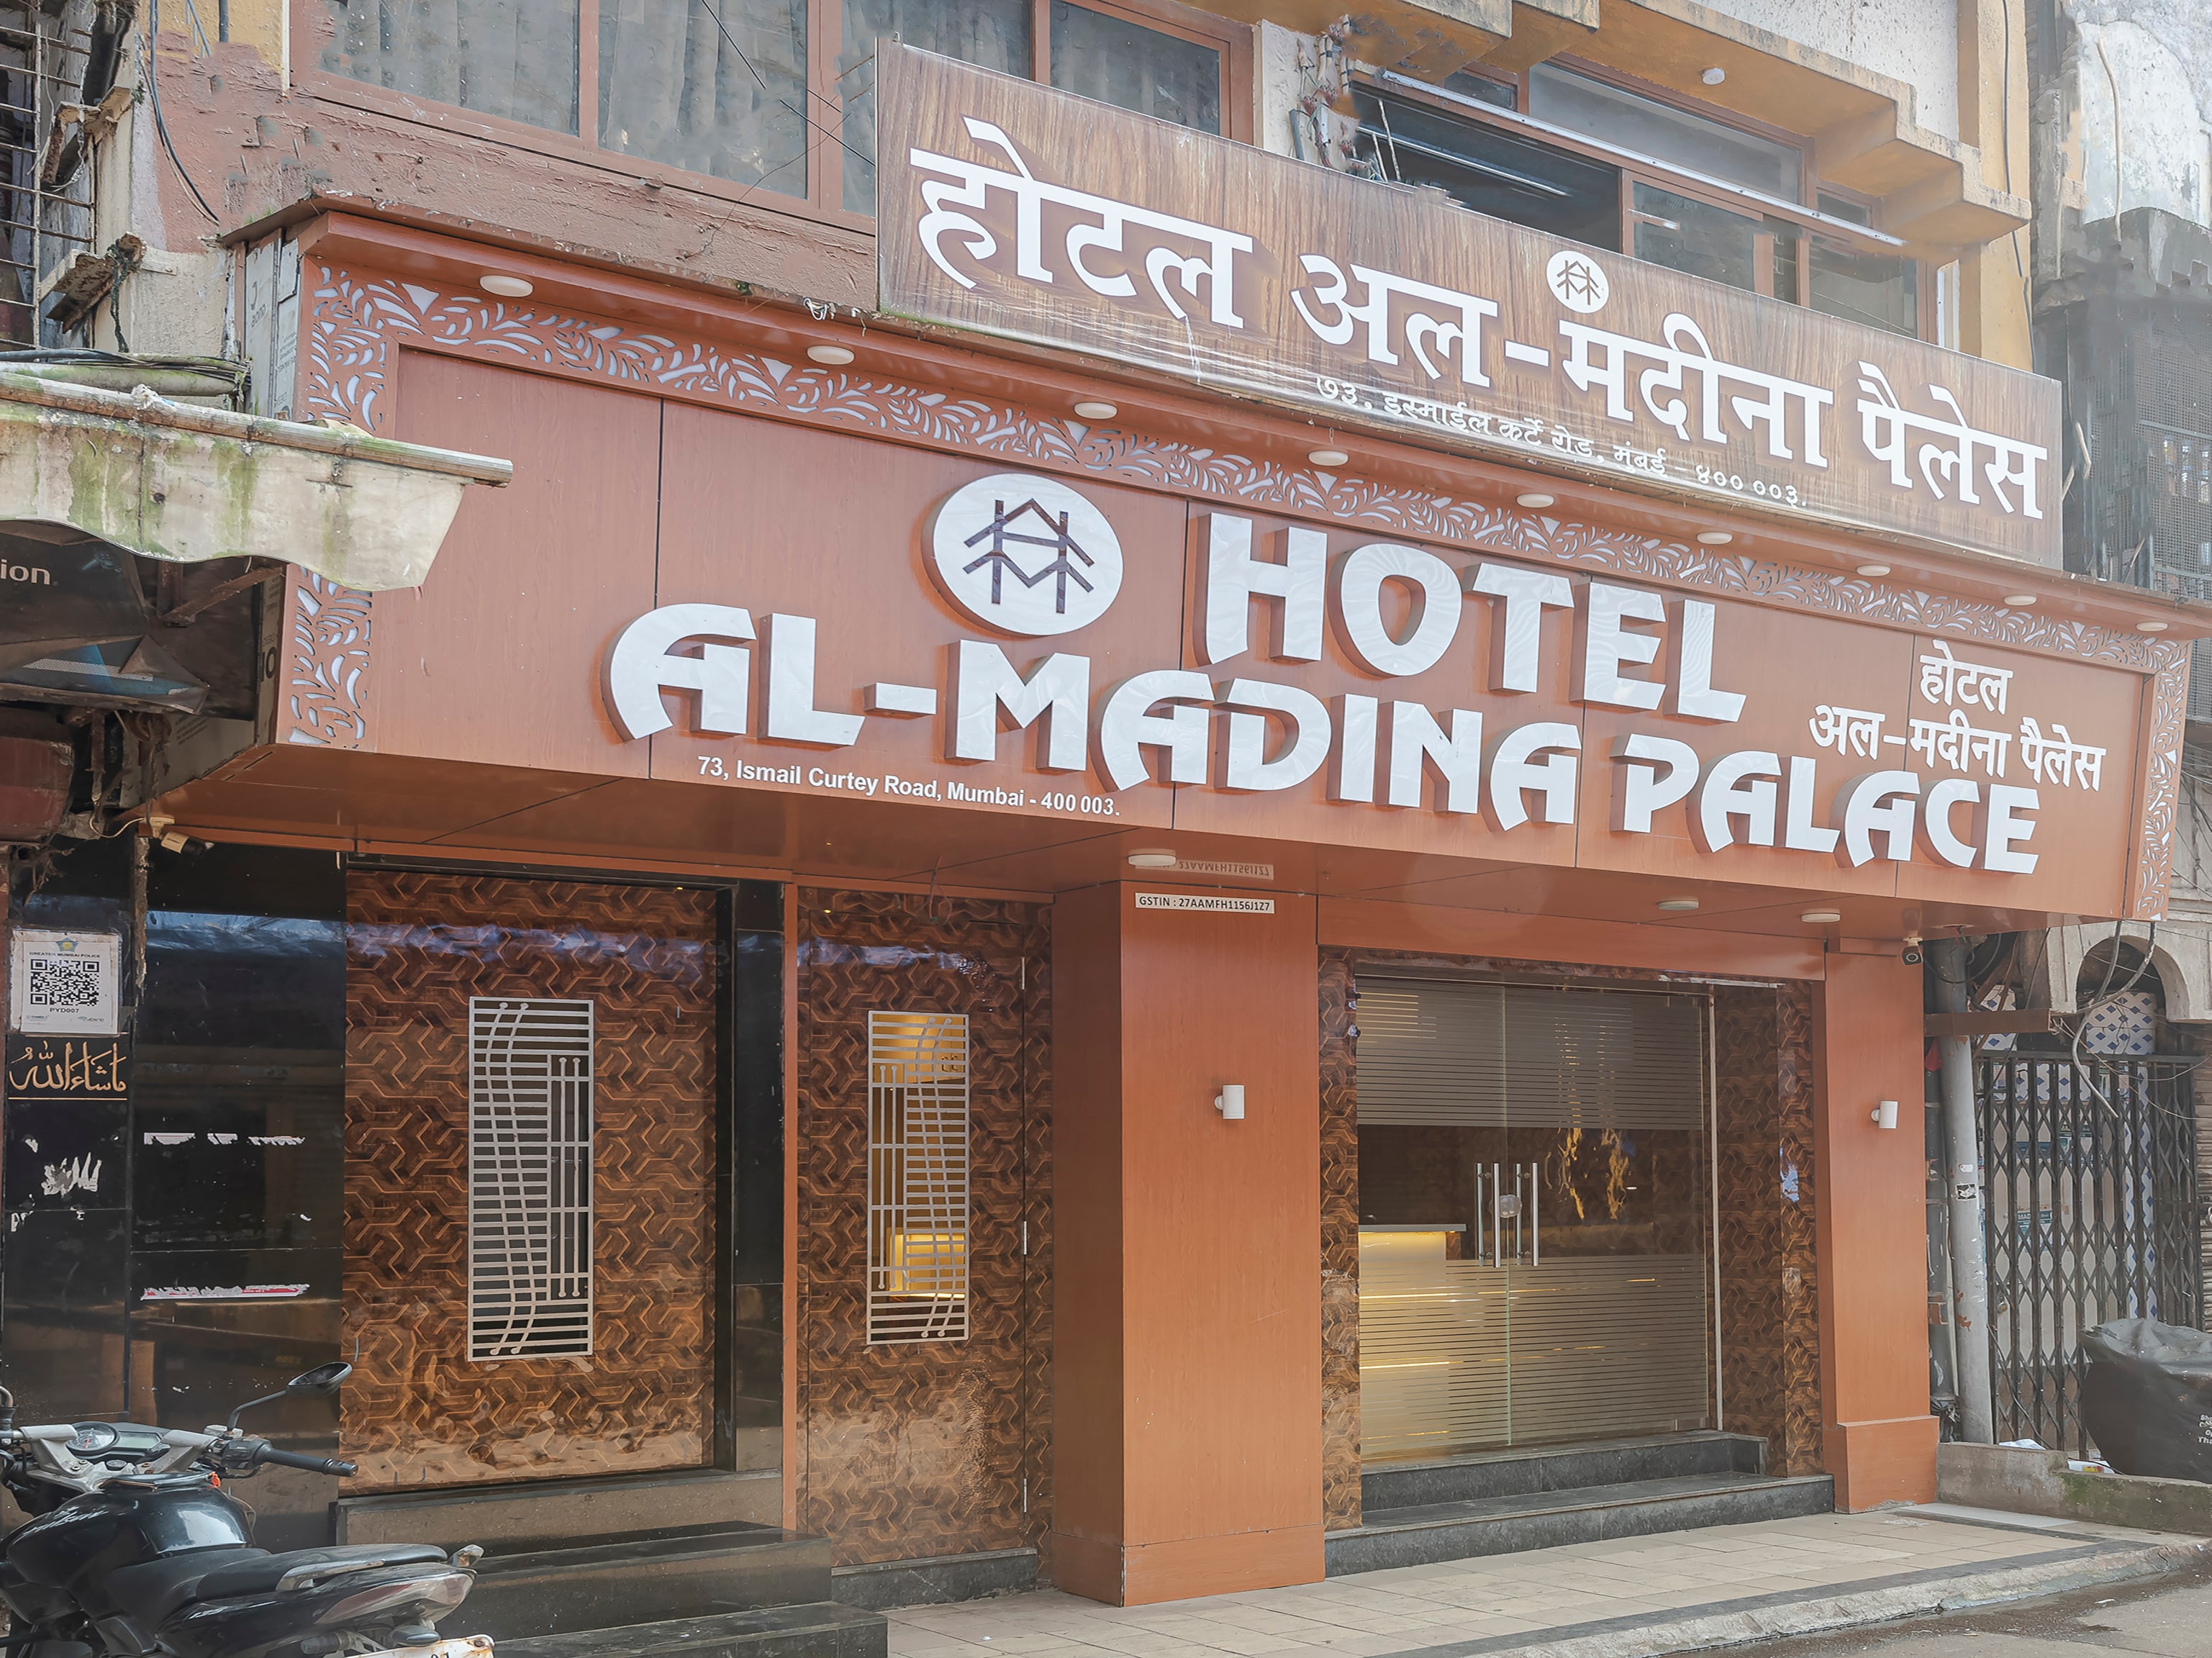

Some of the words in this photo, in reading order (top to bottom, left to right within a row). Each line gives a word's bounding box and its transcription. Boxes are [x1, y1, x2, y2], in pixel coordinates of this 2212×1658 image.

[910, 117, 1252, 329] होटल
[1857, 361, 2047, 520] पैलेस
[1205, 512, 1746, 723] HOTEL
[1920, 639, 2013, 715] होटल
[698, 756, 730, 781] 73,
[736, 760, 801, 785] Ismail
[808, 768, 878, 796] Curtey
[884, 774, 942, 799] Road,
[947, 782, 1024, 807] Mumbai
[1041, 794, 1075, 812] 400
[1080, 798, 1120, 816] 003.
[2021, 717, 2107, 792] पैलेस
[1623, 733, 2039, 874] PALACE
[1139, 896, 1170, 907] GSTIN
[1179, 898, 1270, 911] 27AAMFH1156J1Z7
